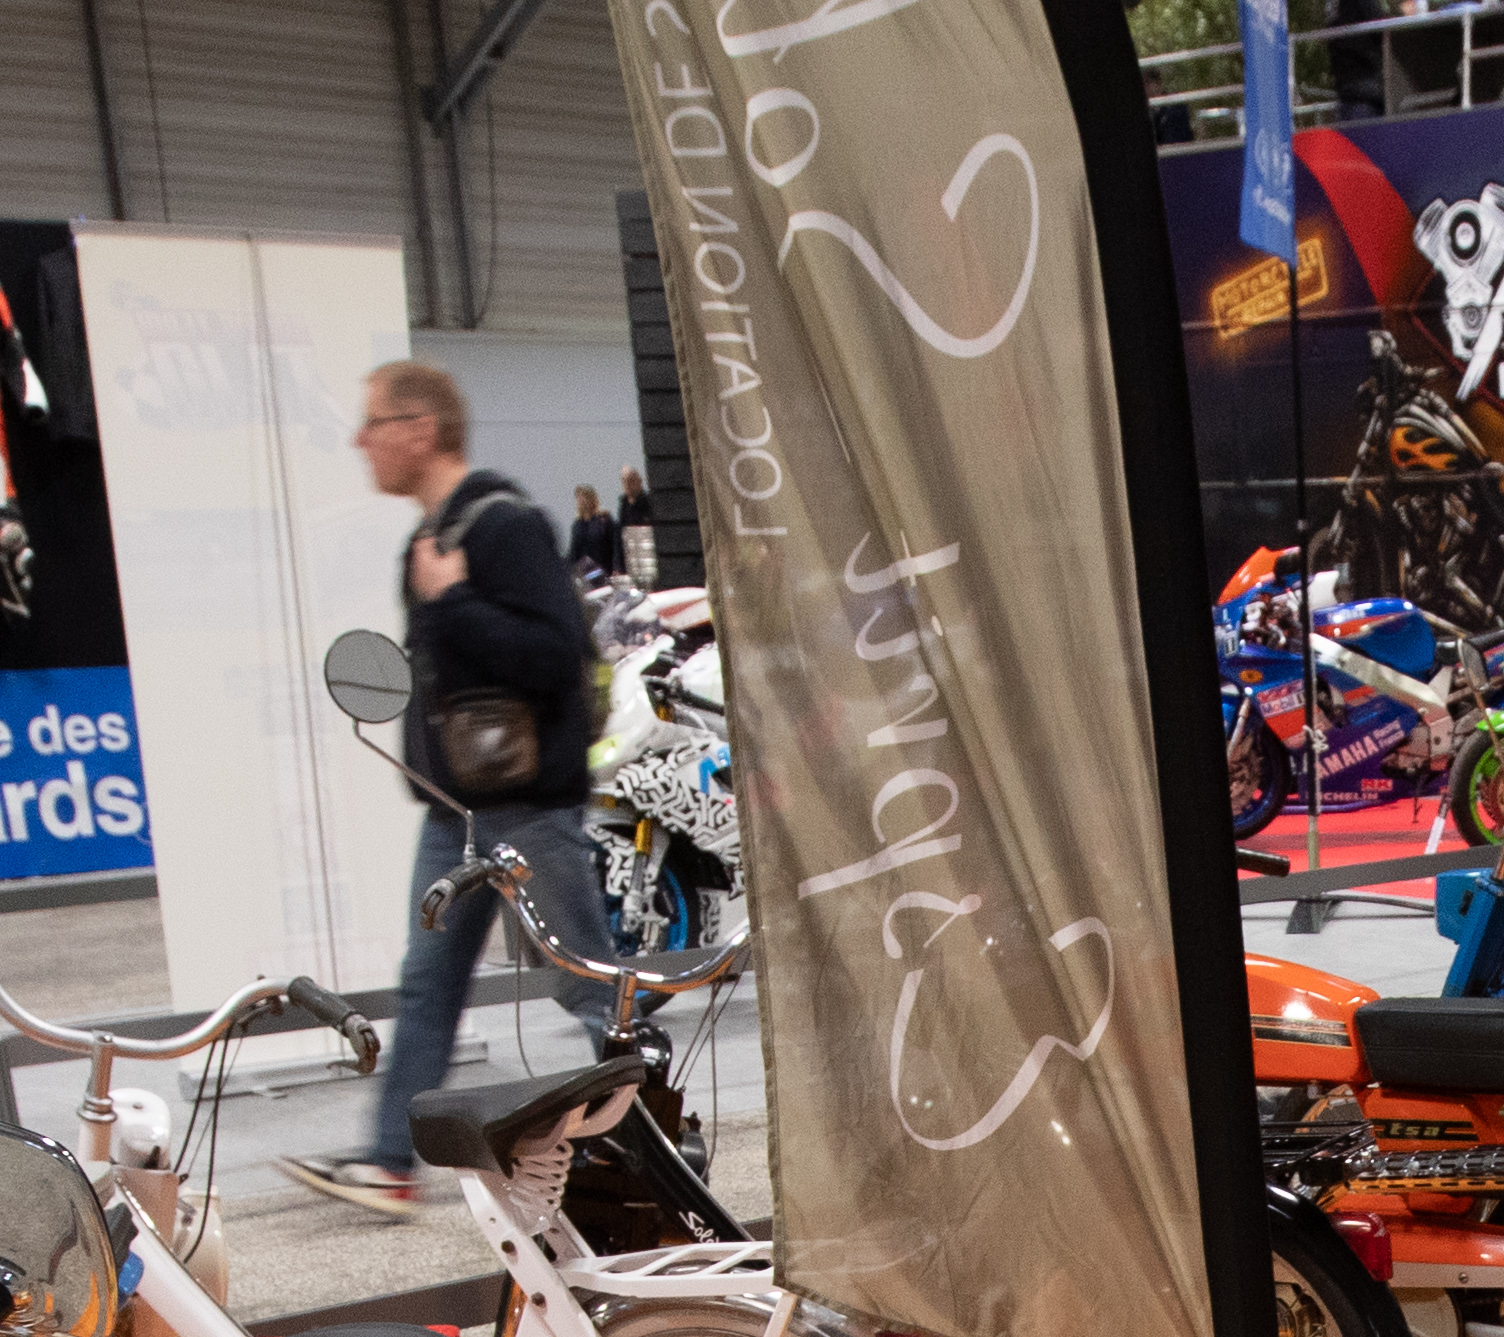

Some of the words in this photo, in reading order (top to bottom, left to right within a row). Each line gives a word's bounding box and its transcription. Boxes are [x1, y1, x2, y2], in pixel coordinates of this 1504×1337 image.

[29, 704, 131, 755] des
[1314, 735, 1380, 779] AMAHA
[1390, 1123, 1440, 1136] tsa
